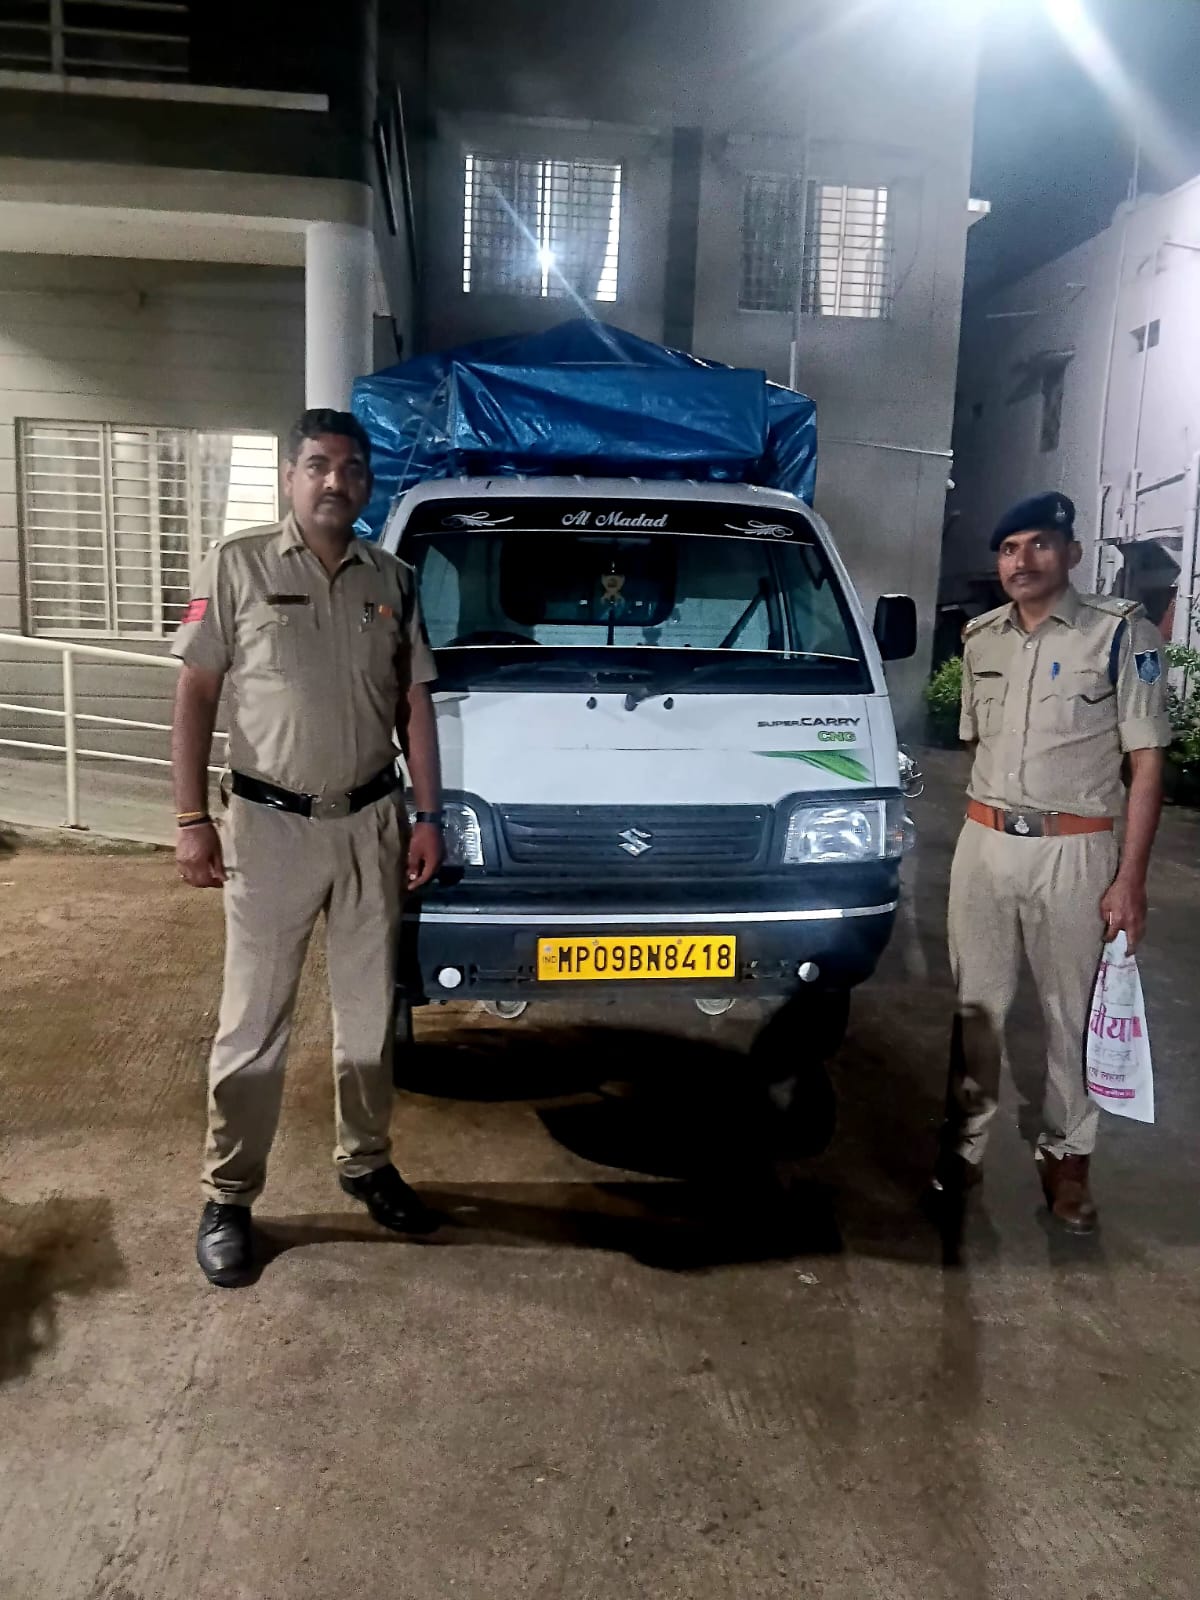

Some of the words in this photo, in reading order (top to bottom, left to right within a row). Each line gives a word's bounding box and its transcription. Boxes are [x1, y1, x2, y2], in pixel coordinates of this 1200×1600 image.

[561, 510, 592, 526] Al
[595, 511, 669, 527] Madad
[817, 730, 857, 742] CNG
[558, 944, 731, 973] MP09BN8418
